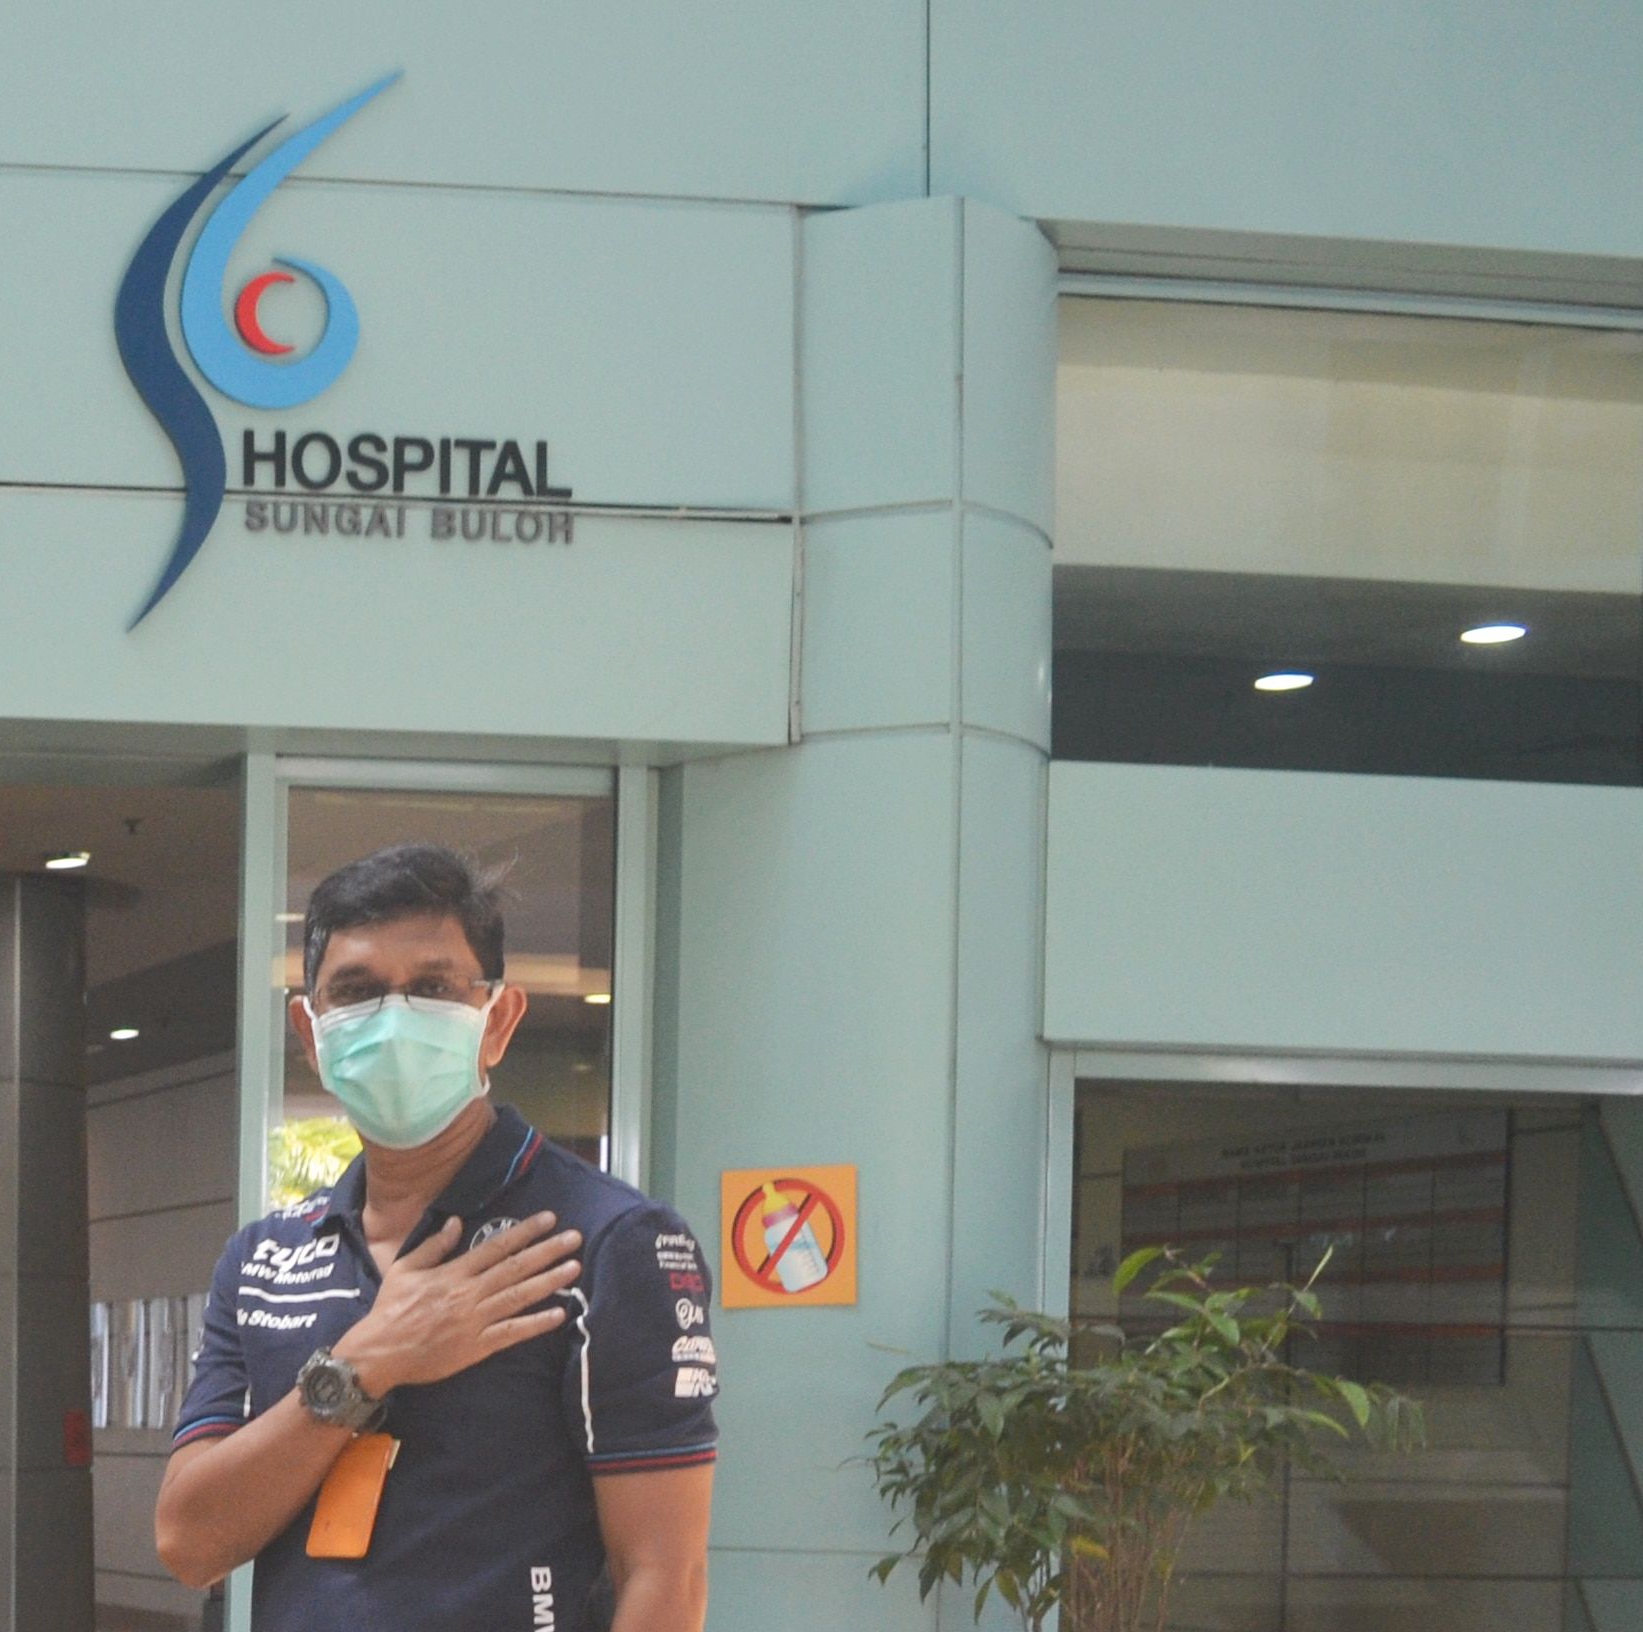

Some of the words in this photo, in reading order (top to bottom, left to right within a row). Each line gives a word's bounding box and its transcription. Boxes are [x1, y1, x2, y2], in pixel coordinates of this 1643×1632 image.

[242, 429, 573, 499] HOSPITAL
[244, 501, 407, 538] SUNGAI
[430, 507, 575, 545] BULOH
